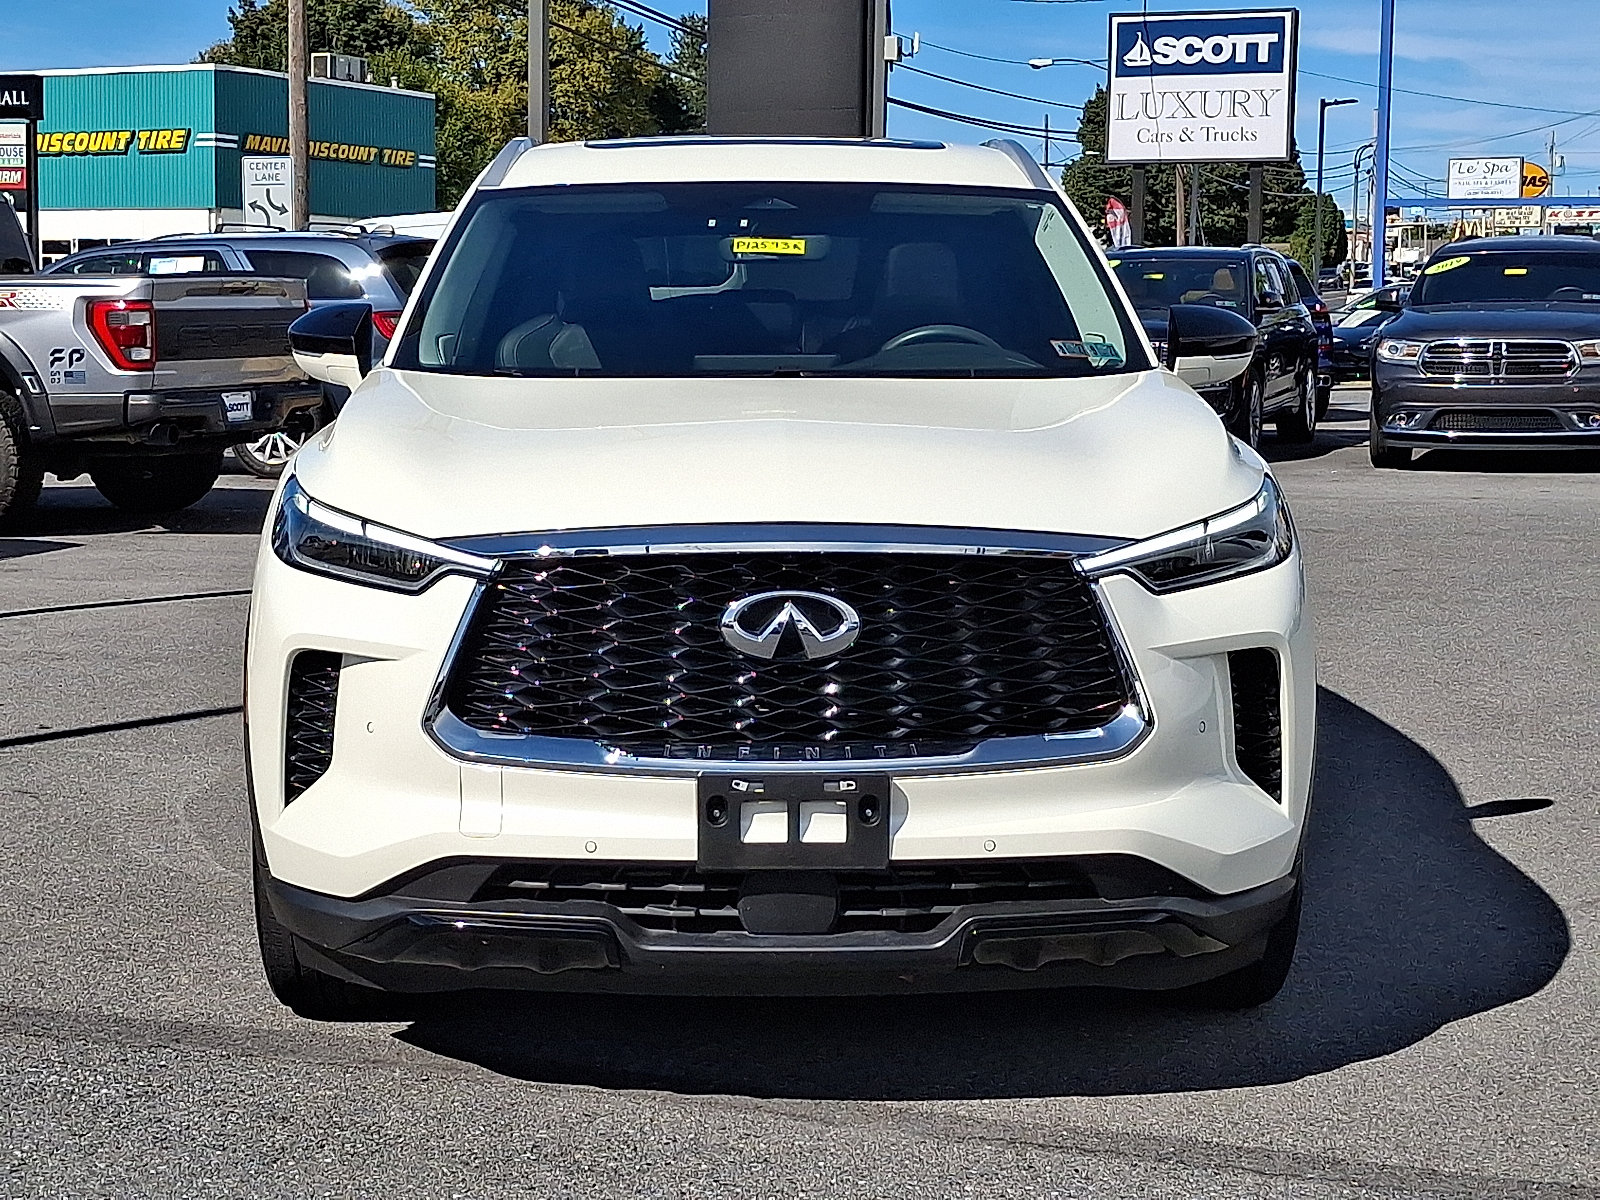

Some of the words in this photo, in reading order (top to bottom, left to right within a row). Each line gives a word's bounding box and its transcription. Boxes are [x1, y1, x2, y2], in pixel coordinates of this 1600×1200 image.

[1153, 33, 1279, 65] SCOTT
[1115, 89, 1282, 121] LUXURY
[138, 129, 186, 150] TIRE
[1136, 128, 1173, 144] Cars
[1179, 127, 1194, 142] &
[1200, 126, 1258, 142] Trucks
[382, 148, 416, 166] TIRE
[249, 162, 286, 171] CENTER
[1483, 161, 1511, 176] Spa
[255, 173, 281, 182] LANE
[228, 402, 250, 412] SCOTT
[663, 743, 918, 760] INFINITI
